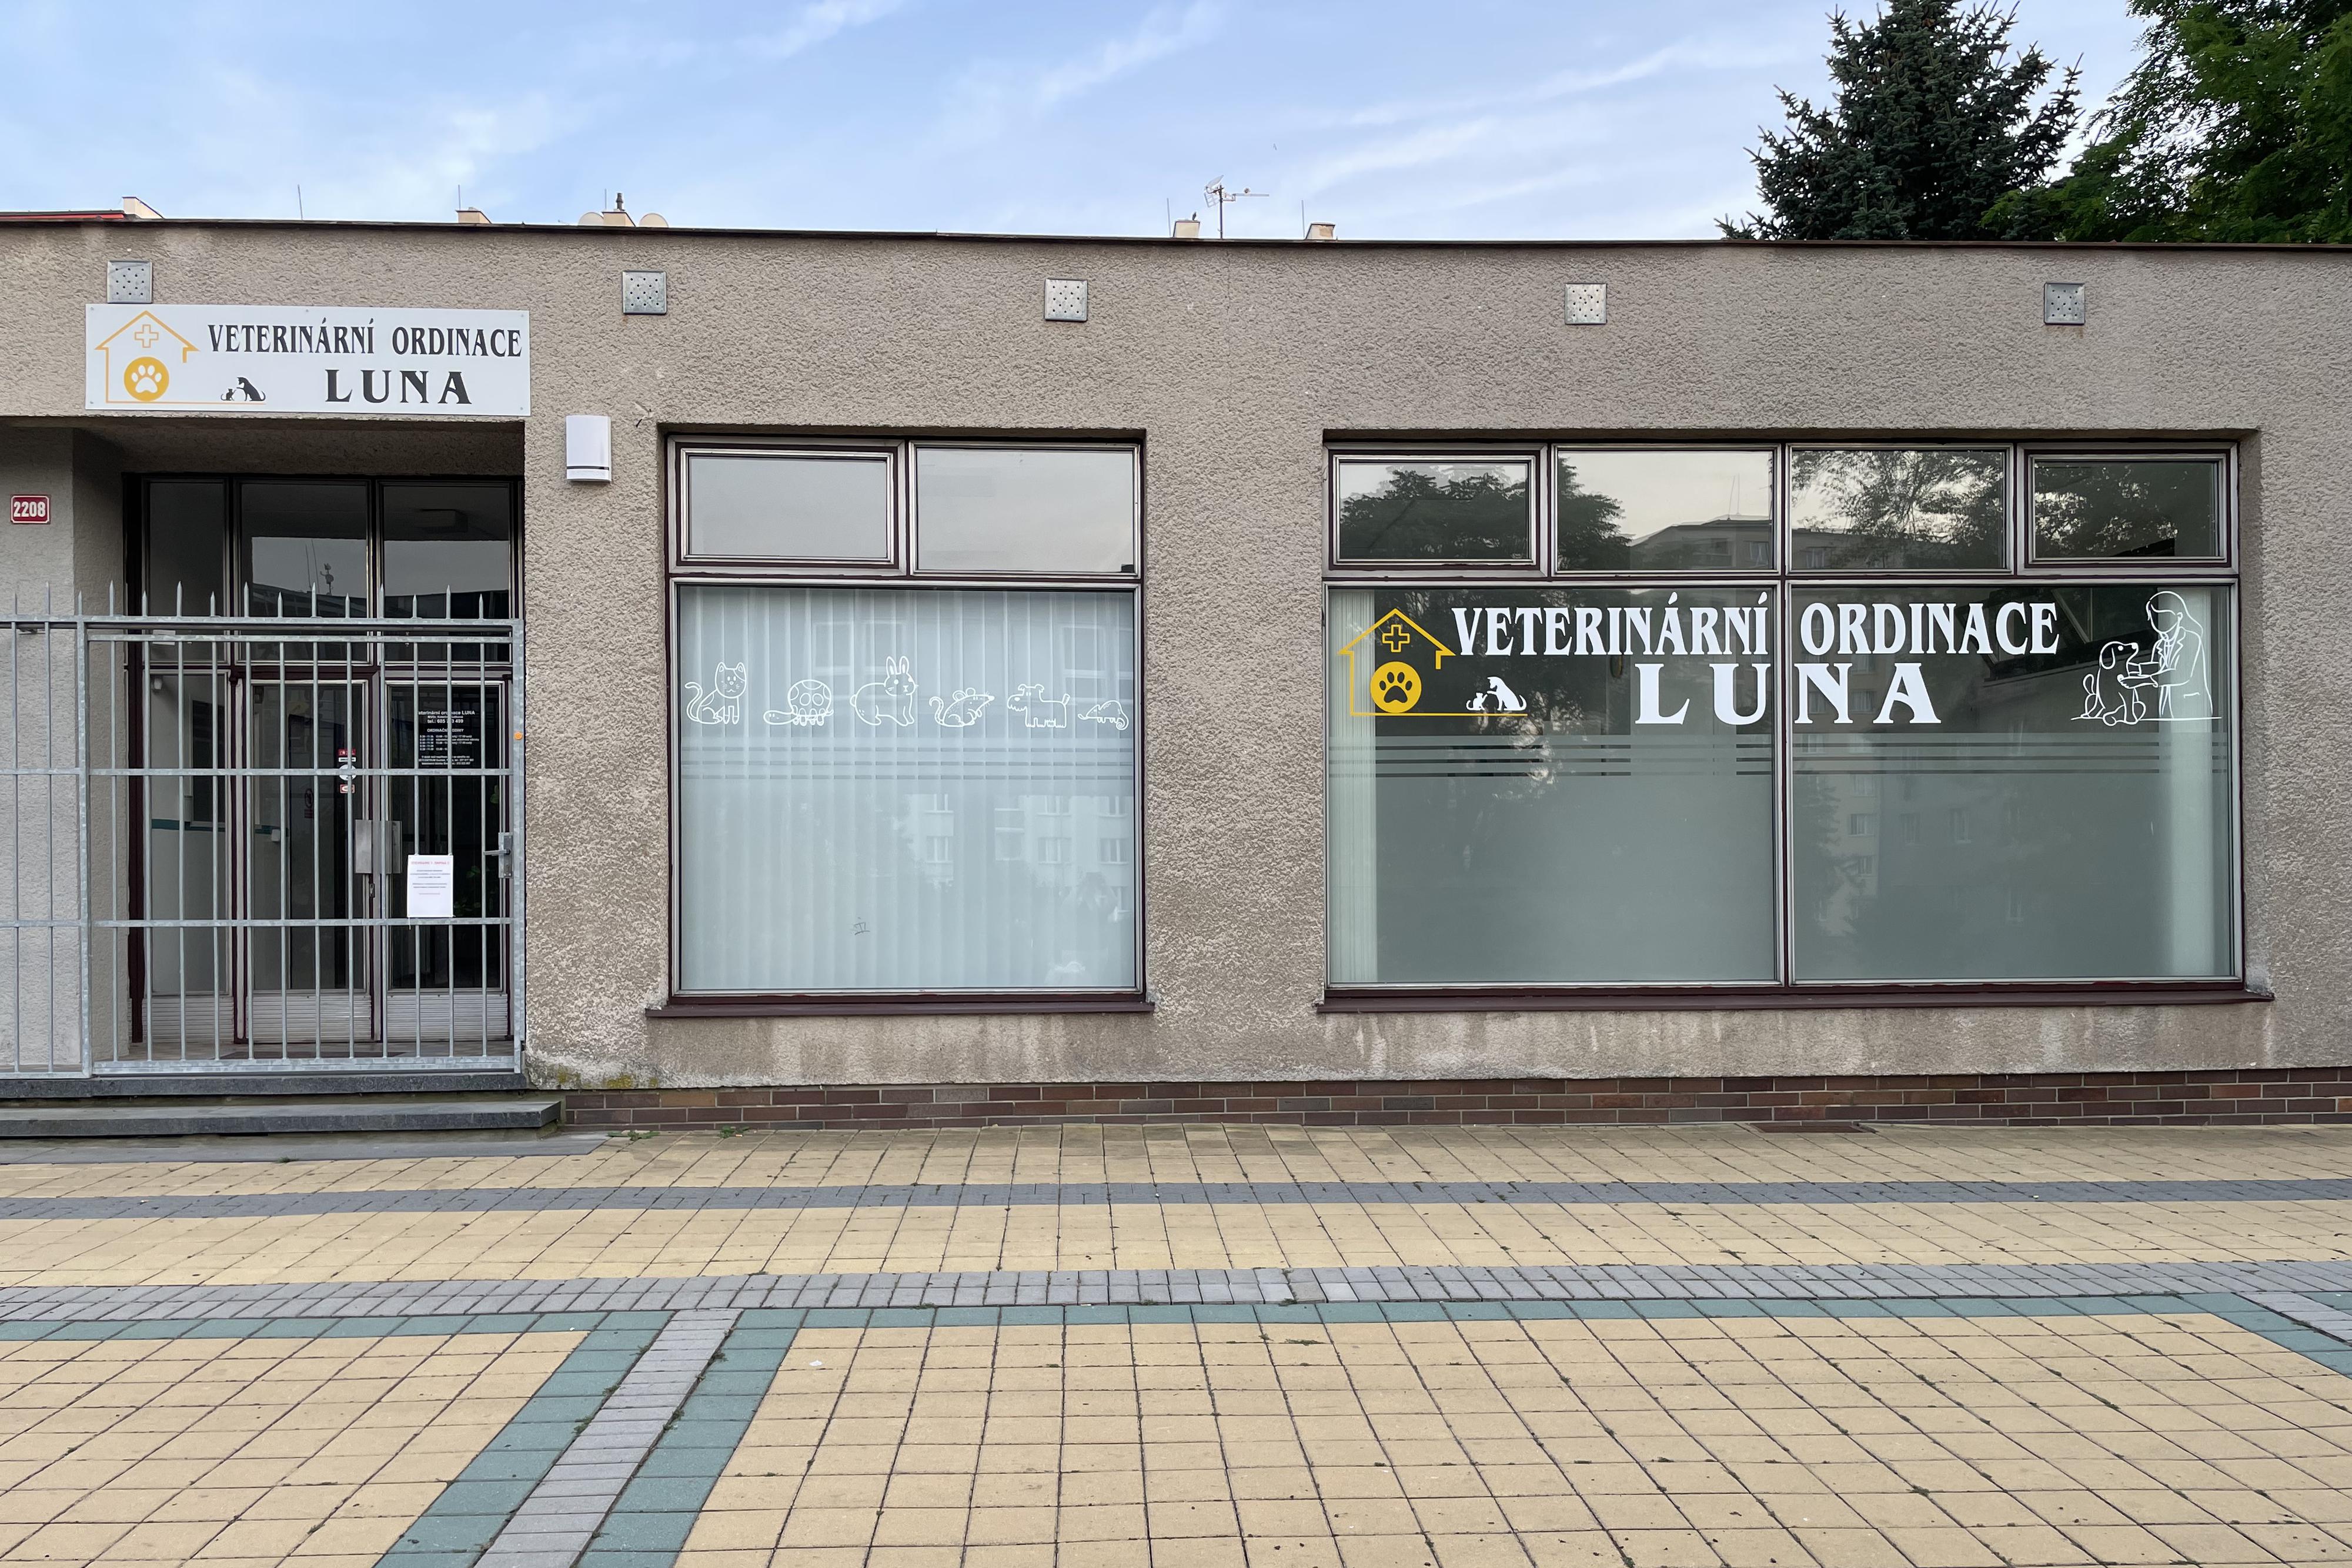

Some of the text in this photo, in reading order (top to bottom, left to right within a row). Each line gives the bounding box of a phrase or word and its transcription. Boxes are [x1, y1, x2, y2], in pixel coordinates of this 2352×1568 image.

[208, 317, 522, 357] VETERINÁRNÍ ORDINACE
[325, 369, 472, 404] LUNA
[14, 501, 46, 517] 2208
[1452, 591, 2059, 656] VETERINÁRNÍ ORDINACE
[1635, 663, 1942, 726] LUNA
